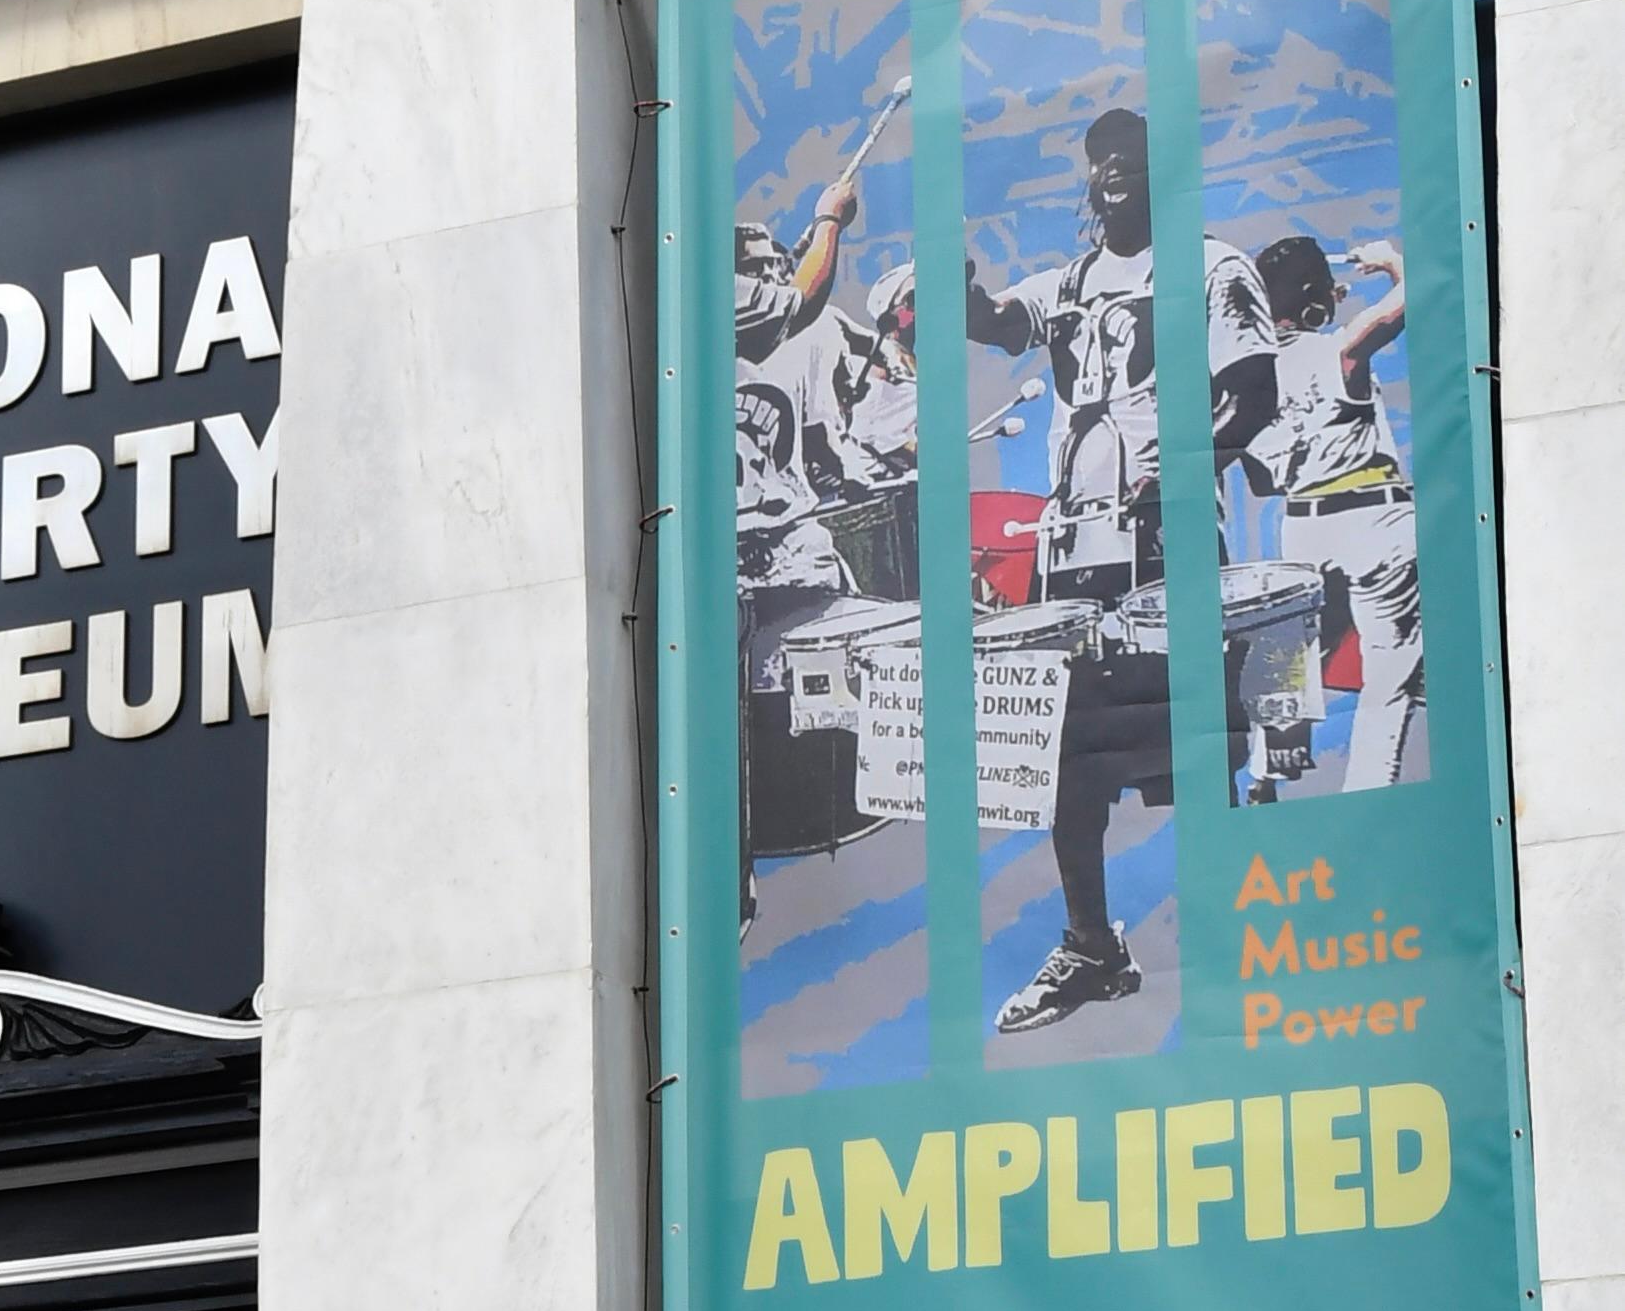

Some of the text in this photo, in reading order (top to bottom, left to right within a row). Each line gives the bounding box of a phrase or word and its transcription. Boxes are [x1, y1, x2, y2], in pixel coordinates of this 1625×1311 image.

[899, 664, 923, 682] do
[983, 666, 1036, 686] GUNZ
[1042, 668, 1059, 686] &
[869, 692, 902, 710] Pick
[983, 696, 1054, 716] DRUMS
[873, 721, 891, 737] for
[896, 725, 904, 737] a
[1234, 854, 1335, 911] Art
[1238, 911, 1422, 979] Music
[1244, 992, 1425, 1050] Power
[743, 1083, 1451, 1290] AMPLIFIED
